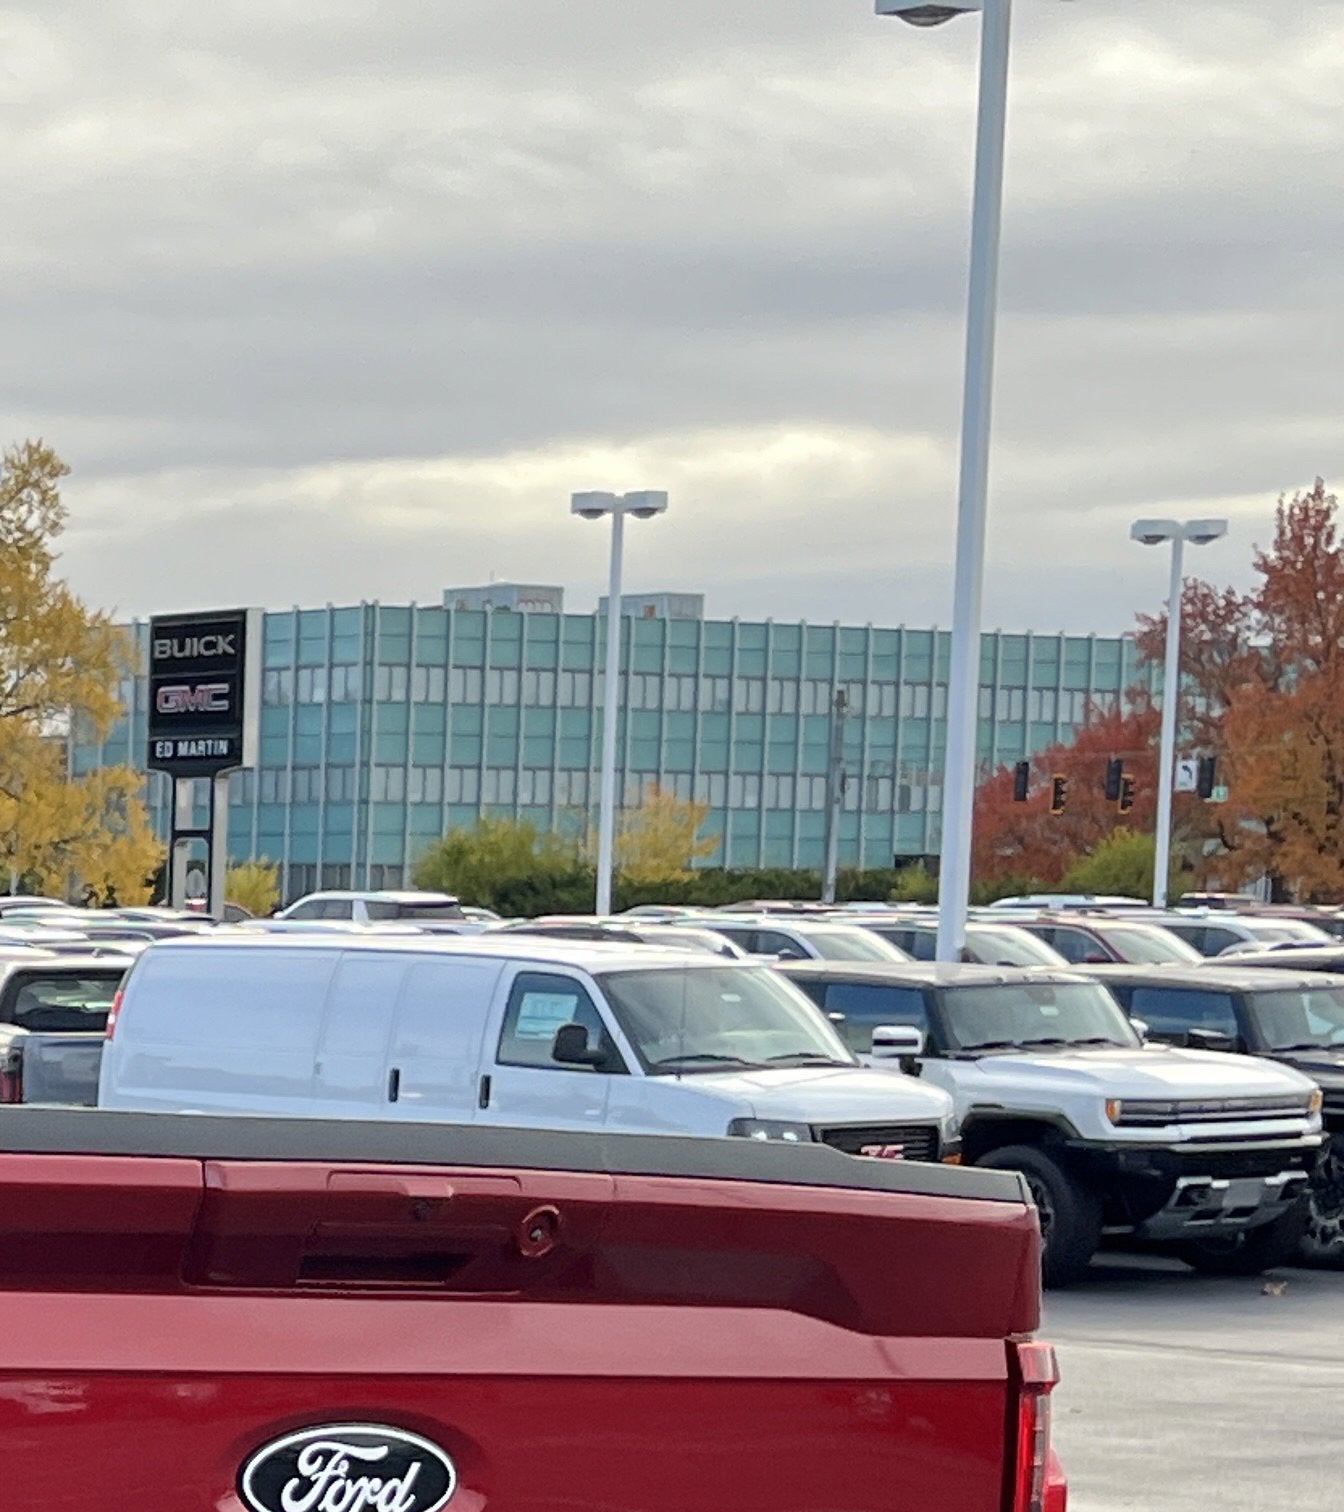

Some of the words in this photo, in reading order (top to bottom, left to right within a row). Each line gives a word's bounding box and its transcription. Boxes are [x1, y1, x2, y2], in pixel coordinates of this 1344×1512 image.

[153, 634, 235, 659] BUICK
[156, 683, 230, 714] GMC
[155, 741, 174, 759] ED
[177, 739, 229, 758] MARTIN
